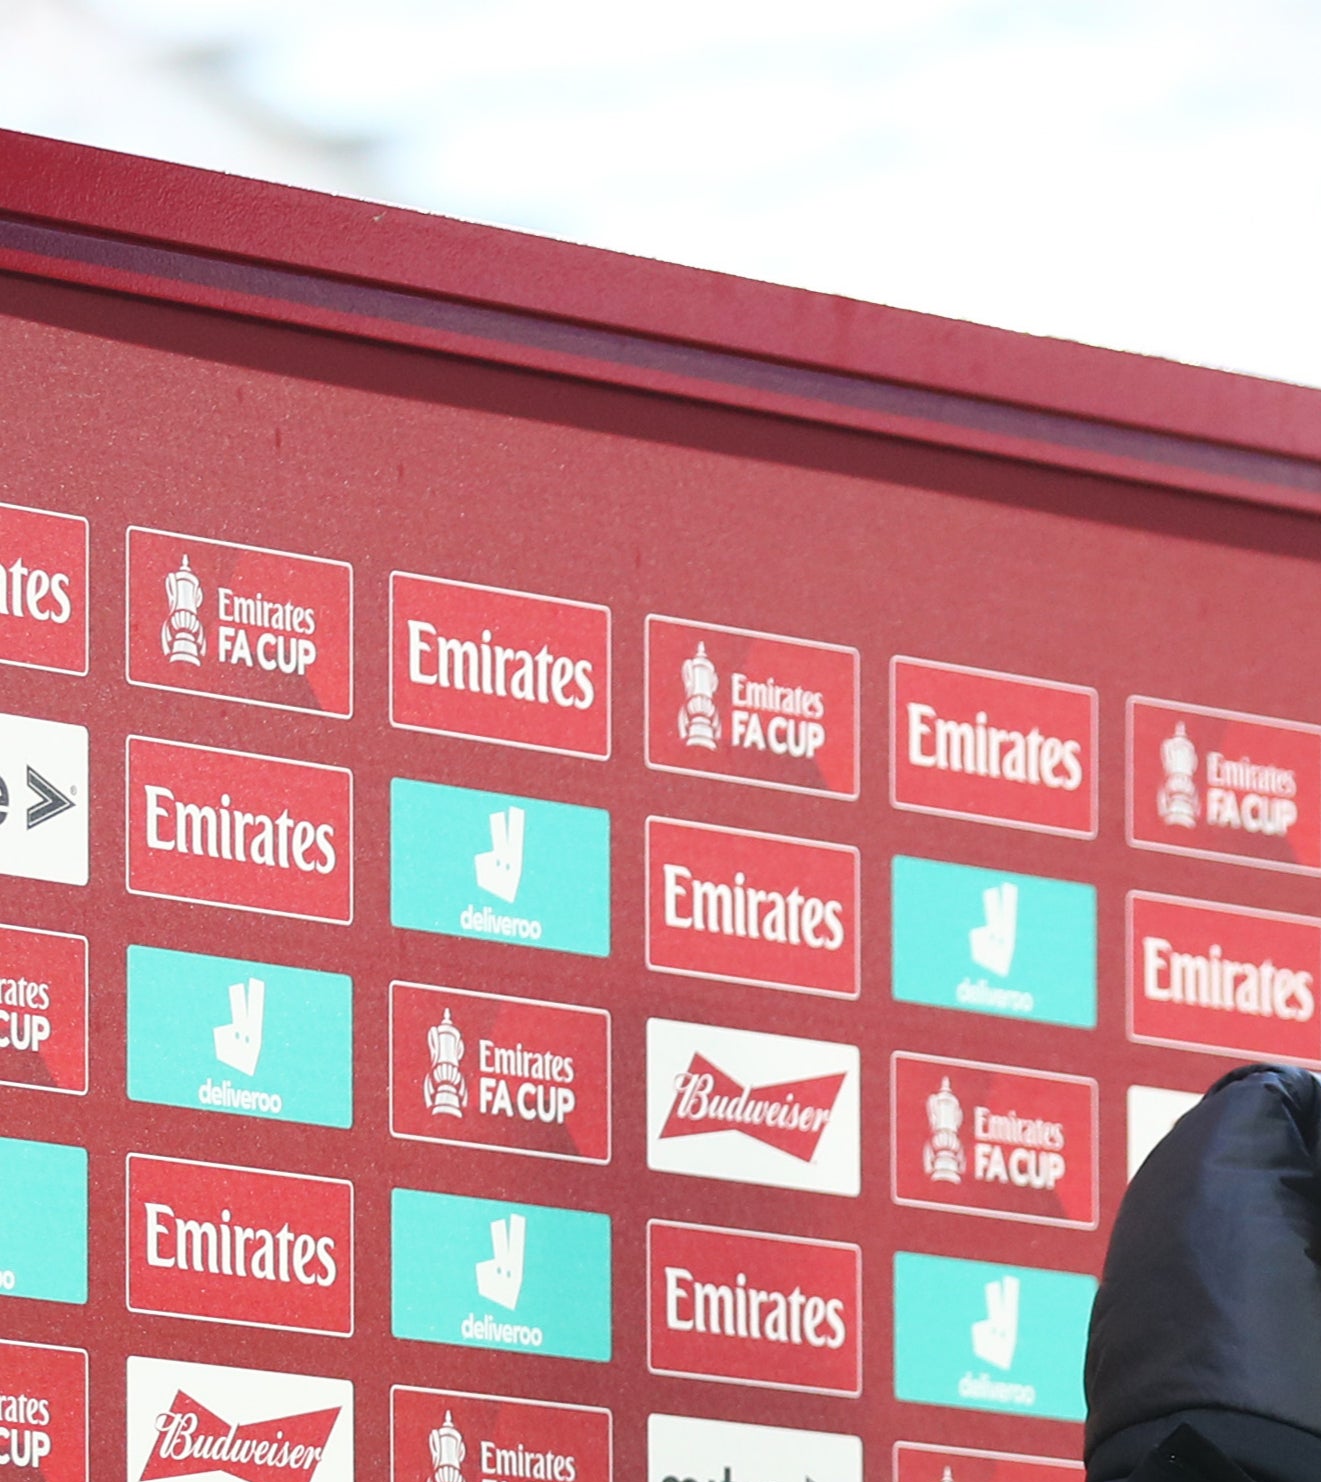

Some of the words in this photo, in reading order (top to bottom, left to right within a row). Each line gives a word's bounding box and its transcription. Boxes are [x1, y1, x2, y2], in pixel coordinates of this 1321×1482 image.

[219, 588, 314, 641] Emirates
[219, 626, 252, 666] FA
[257, 633, 316, 675] CUP
[408, 620, 593, 709] Emirates
[732, 673, 823, 718] Emirates
[733, 711, 765, 749] FA
[768, 717, 824, 757] CUP
[908, 703, 1081, 790] Emirates
[1207, 752, 1296, 796] Emirates
[145, 785, 335, 873] Emirates
[1208, 788, 1241, 825] FA
[1237, 794, 1297, 834] CUP
[461, 905, 542, 939] deliveroo
[664, 864, 843, 949] Emirates
[1144, 937, 1314, 1021] Emirates
[480, 1040, 573, 1082] Emirates
[199, 1079, 282, 1113] deliveroo
[480, 1078, 513, 1116] FA
[517, 1083, 574, 1123] CUP
[672, 1070, 832, 1133] Budweiser
[975, 1107, 1064, 1150] Emirates
[975, 1144, 1008, 1181] FA
[1009, 1148, 1065, 1188] CUP
[145, 1203, 336, 1286] Emirates
[461, 1313, 542, 1346] deliveroo
[665, 1267, 845, 1348] Emirates
[155, 1412, 325, 1471] Budweiser
[481, 1441, 575, 1482] Emirates
